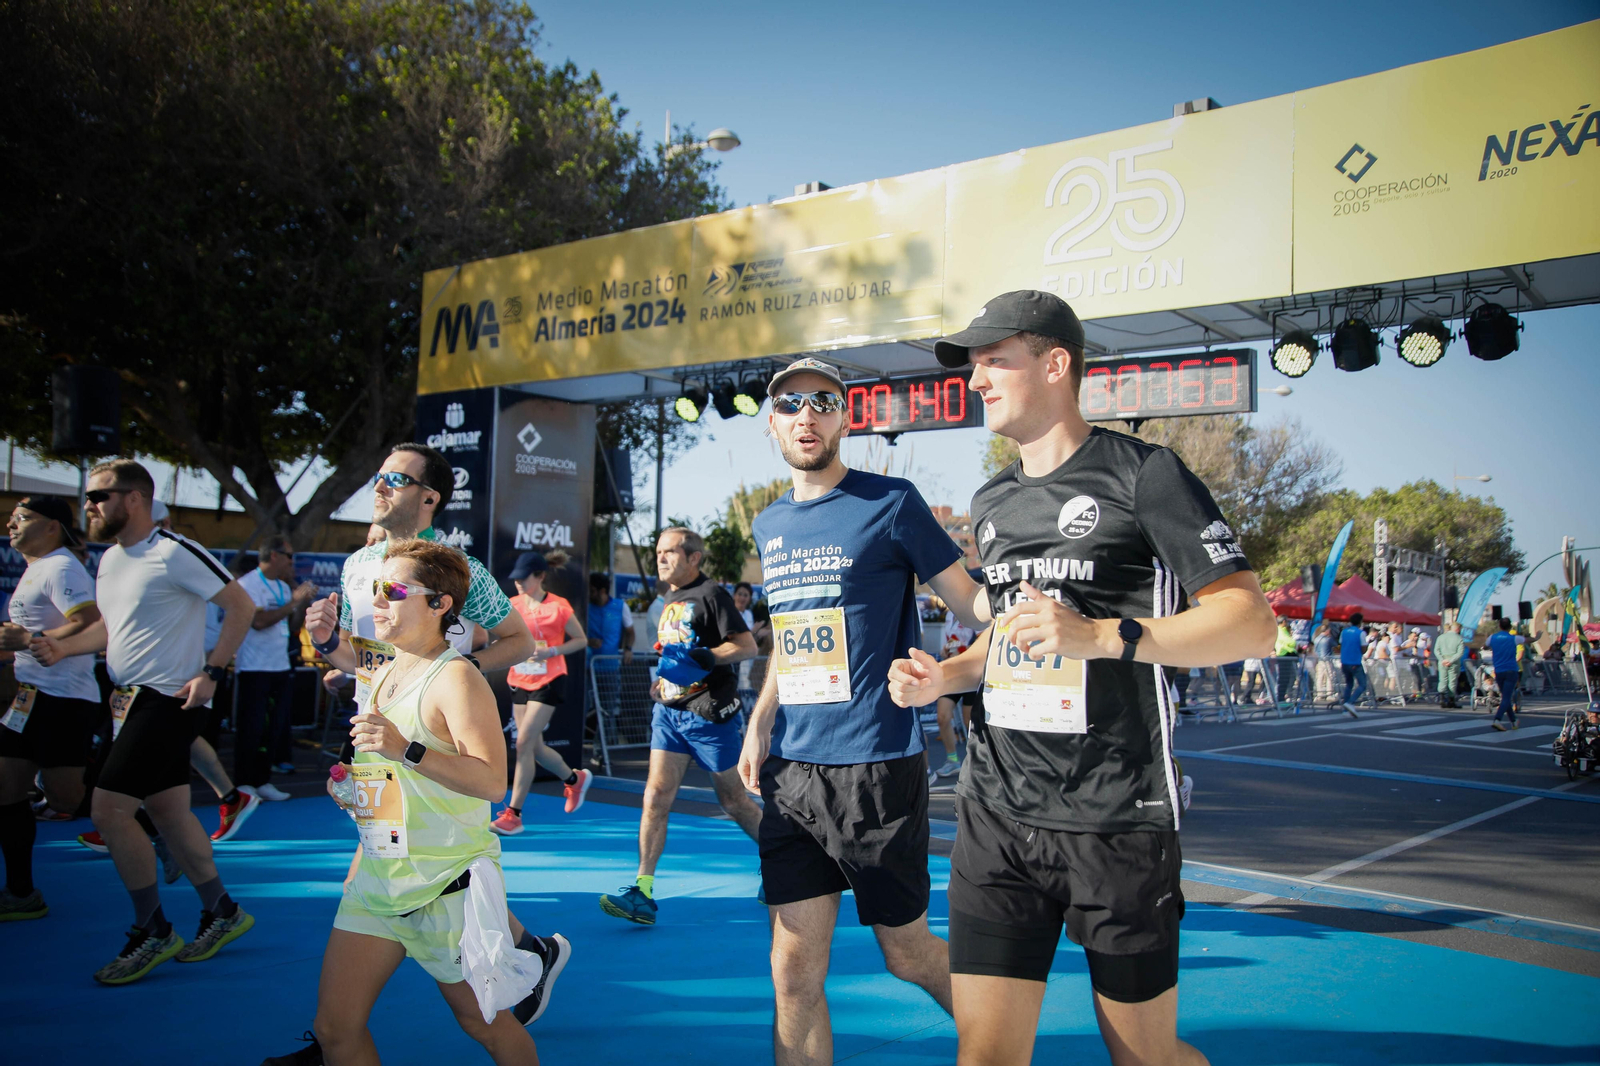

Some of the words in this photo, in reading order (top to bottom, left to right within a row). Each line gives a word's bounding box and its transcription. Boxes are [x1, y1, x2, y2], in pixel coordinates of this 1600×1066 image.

[1490, 166, 1518, 180] 2020
[1333, 172, 1448, 203] COOPERACIÓN
[1043, 138, 1186, 266] 25
[1333, 200, 1371, 217] 2005
[536, 285, 593, 312] Medio
[600, 270, 688, 302] Maratón
[700, 300, 756, 321] RAMÓN
[763, 293, 802, 312] RUIZ
[808, 280, 892, 306] ANDÚJAR
[534, 306, 616, 343] Almería
[621, 297, 686, 331] 2024
[427, 429, 482, 453] cajamar
[515, 453, 577, 470] COOPERACIÓN
[1082, 511, 1096, 519] FC
[791, 544, 842, 560] Maratón
[1202, 542, 1228, 560] EL
[763, 560, 802, 581] Almería
[782, 577, 800, 587] RUIZ
[801, 573, 842, 584] ANDÚJAR
[982, 562, 1012, 586] ER
[1016, 557, 1094, 581] TRAUM
[777, 626, 835, 656] 1648
[1012, 670, 1032, 680] UWE
[719, 697, 741, 719] FILA
